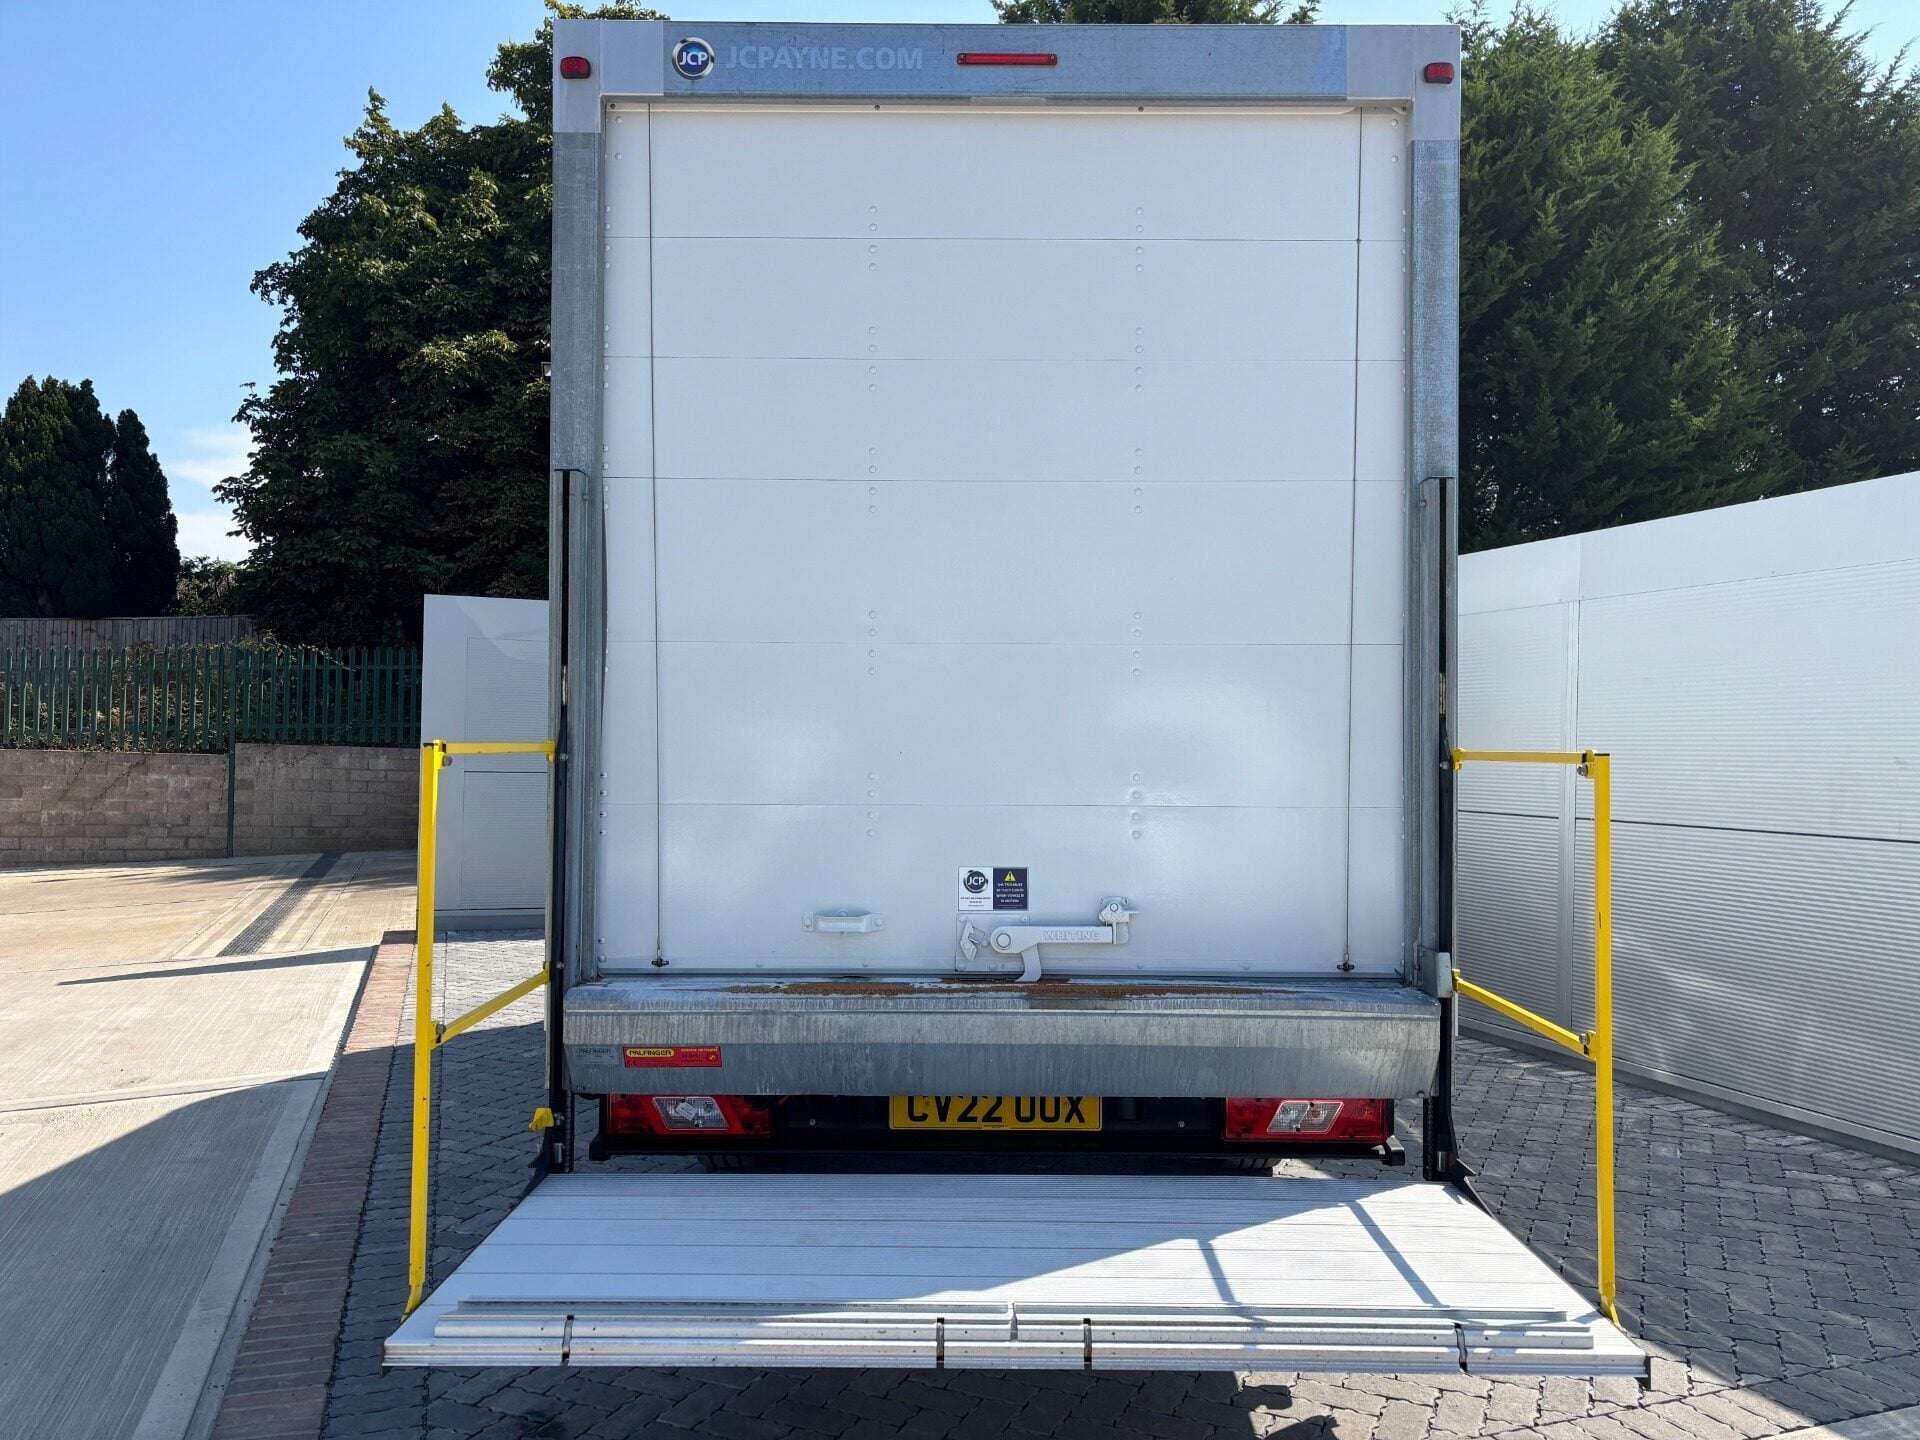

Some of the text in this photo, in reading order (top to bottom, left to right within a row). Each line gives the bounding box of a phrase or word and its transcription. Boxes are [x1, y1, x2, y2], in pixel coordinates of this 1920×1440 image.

[680, 51, 708, 66] JCP
[725, 46, 923, 70] JCPAYNE.COM
[967, 876, 985, 886] JCP
[907, 1096, 1002, 1123] CV22
